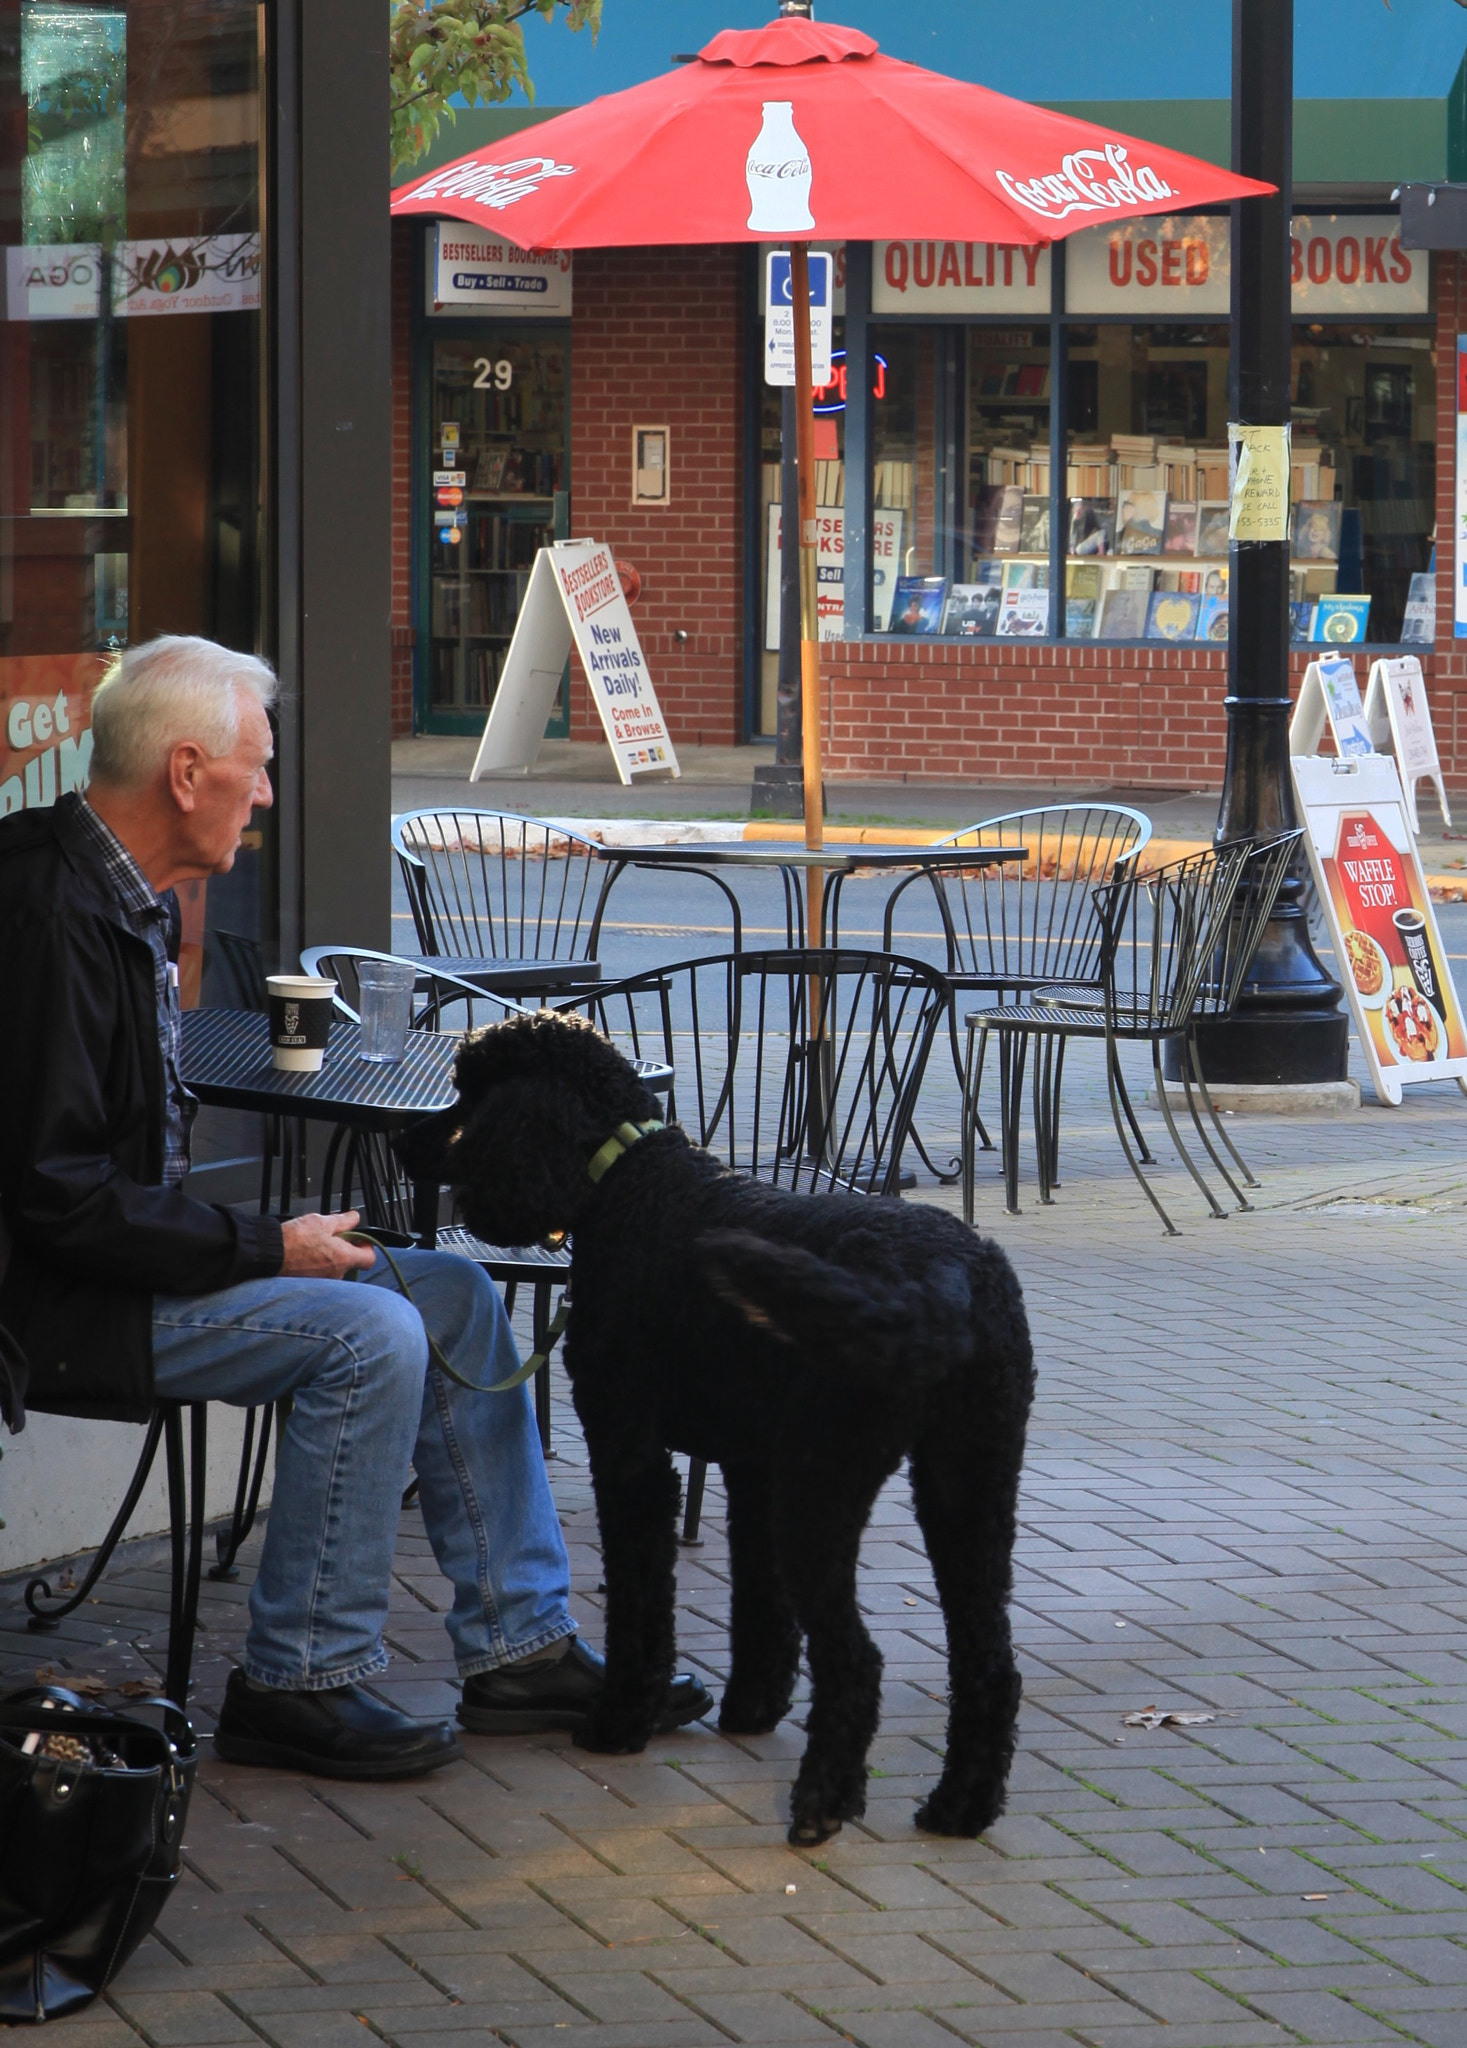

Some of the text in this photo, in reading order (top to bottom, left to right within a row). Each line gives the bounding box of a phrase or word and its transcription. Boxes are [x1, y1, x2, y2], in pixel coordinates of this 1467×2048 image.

[443, 243, 503, 263] BESTSELLERS
[884, 240, 1043, 293] QUALITY
[1109, 240, 1209, 287] USED
[457, 275, 542, 290] Buy Sell Trade
[473, 357, 513, 391] 29
[1244, 488, 1281, 498] REWARD
[1257, 502, 1278, 511] CALL
[1237, 516, 1282, 527] 53-5335
[560, 551, 609, 598] BESTSELLERS
[820, 568, 841, 580] Sell
[574, 573, 616, 623] BOOKSTORE
[590, 624, 622, 645] New
[590, 648, 641, 672] Arrivals
[603, 672, 643, 698] Daily!
[8, 687, 70, 750] Get
[612, 704, 653, 722] Come In
[614, 721, 662, 739] & Browse
[1343, 859, 1396, 883] WAFFLE
[1359, 883, 1398, 908] STOP!
